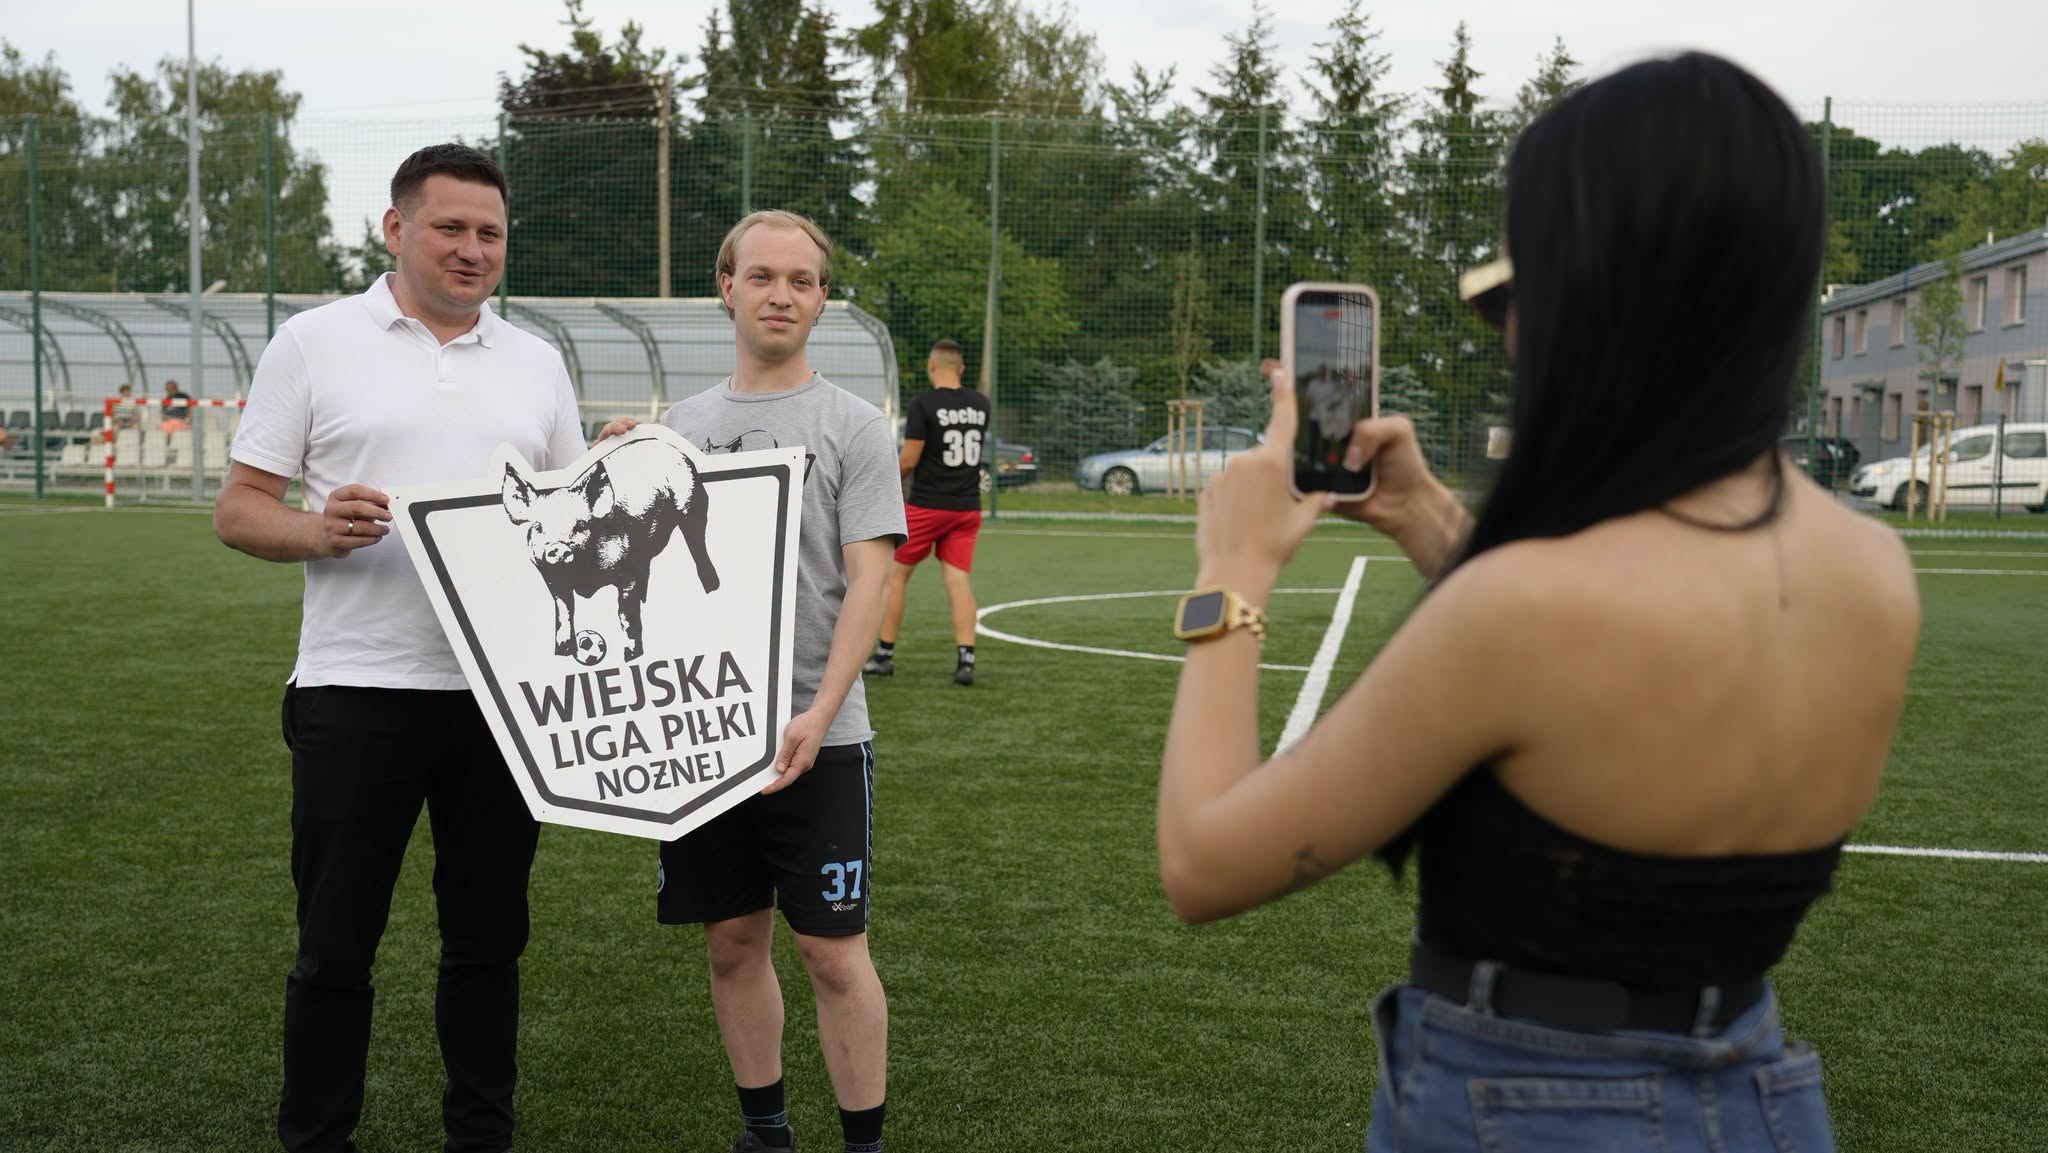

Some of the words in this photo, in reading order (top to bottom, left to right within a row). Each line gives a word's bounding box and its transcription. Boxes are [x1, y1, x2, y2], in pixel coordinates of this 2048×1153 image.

[936, 407, 986, 427] Socha
[942, 429, 982, 467] 36
[518, 651, 753, 727] WIEJSKA
[549, 720, 652, 769] LIGA
[659, 701, 756, 750] PIŁKI
[821, 859, 862, 901] 37
